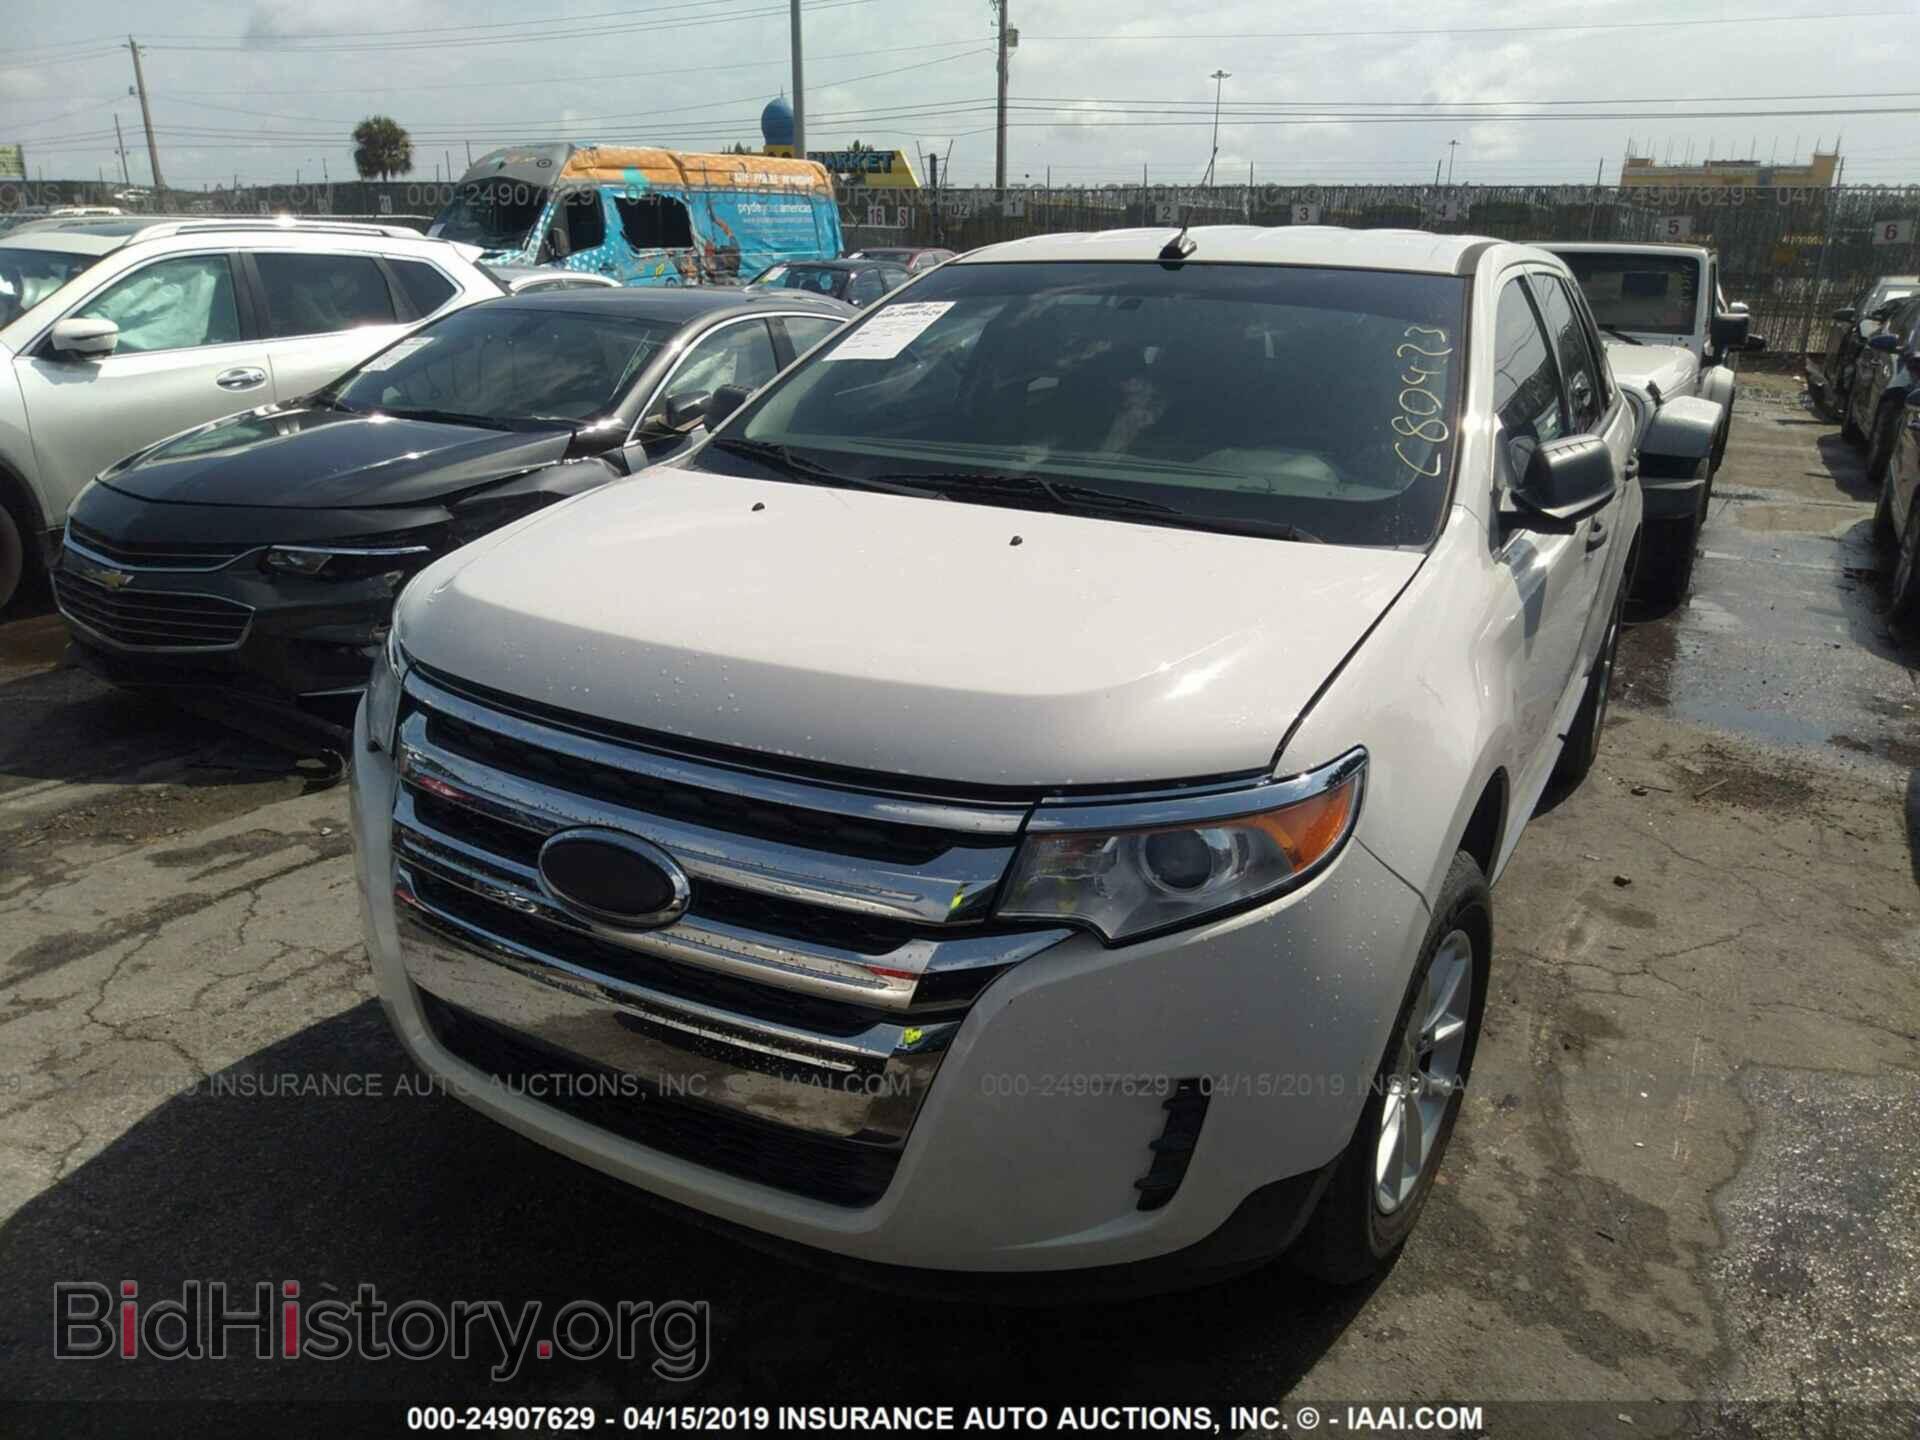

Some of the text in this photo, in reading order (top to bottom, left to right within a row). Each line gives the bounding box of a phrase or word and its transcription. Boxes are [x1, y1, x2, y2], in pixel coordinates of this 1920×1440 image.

[869, 208, 882, 225] 16
[1162, 206, 1171, 220] 2
[1299, 207, 1309, 221] 3
[1438, 203, 1448, 218] 4
[1668, 220, 1680, 235] 5
[1884, 224, 1898, 240] 6
